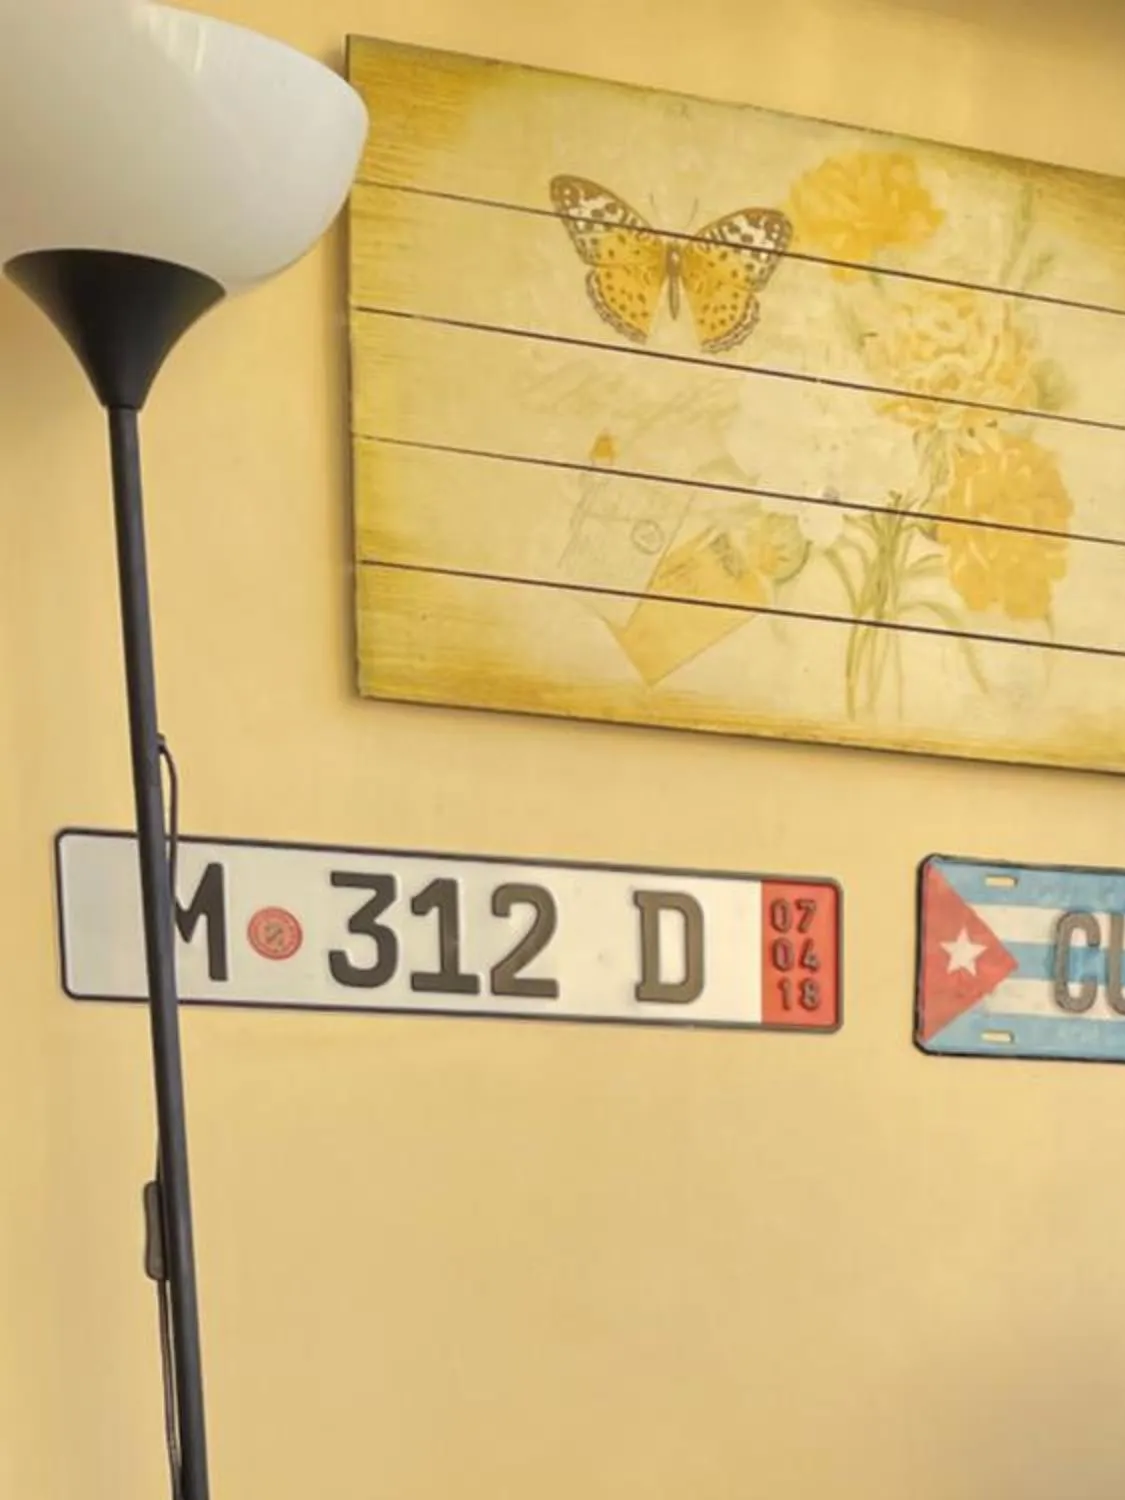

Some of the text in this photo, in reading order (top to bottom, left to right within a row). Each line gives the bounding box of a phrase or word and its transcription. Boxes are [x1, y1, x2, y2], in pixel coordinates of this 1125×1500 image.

[174, 862, 228, 981] M
[329, 872, 559, 999] 312
[633, 891, 704, 1003] D
[770, 898, 817, 934] 07
[771, 937, 820, 973] 04
[777, 978, 820, 1012] 18
